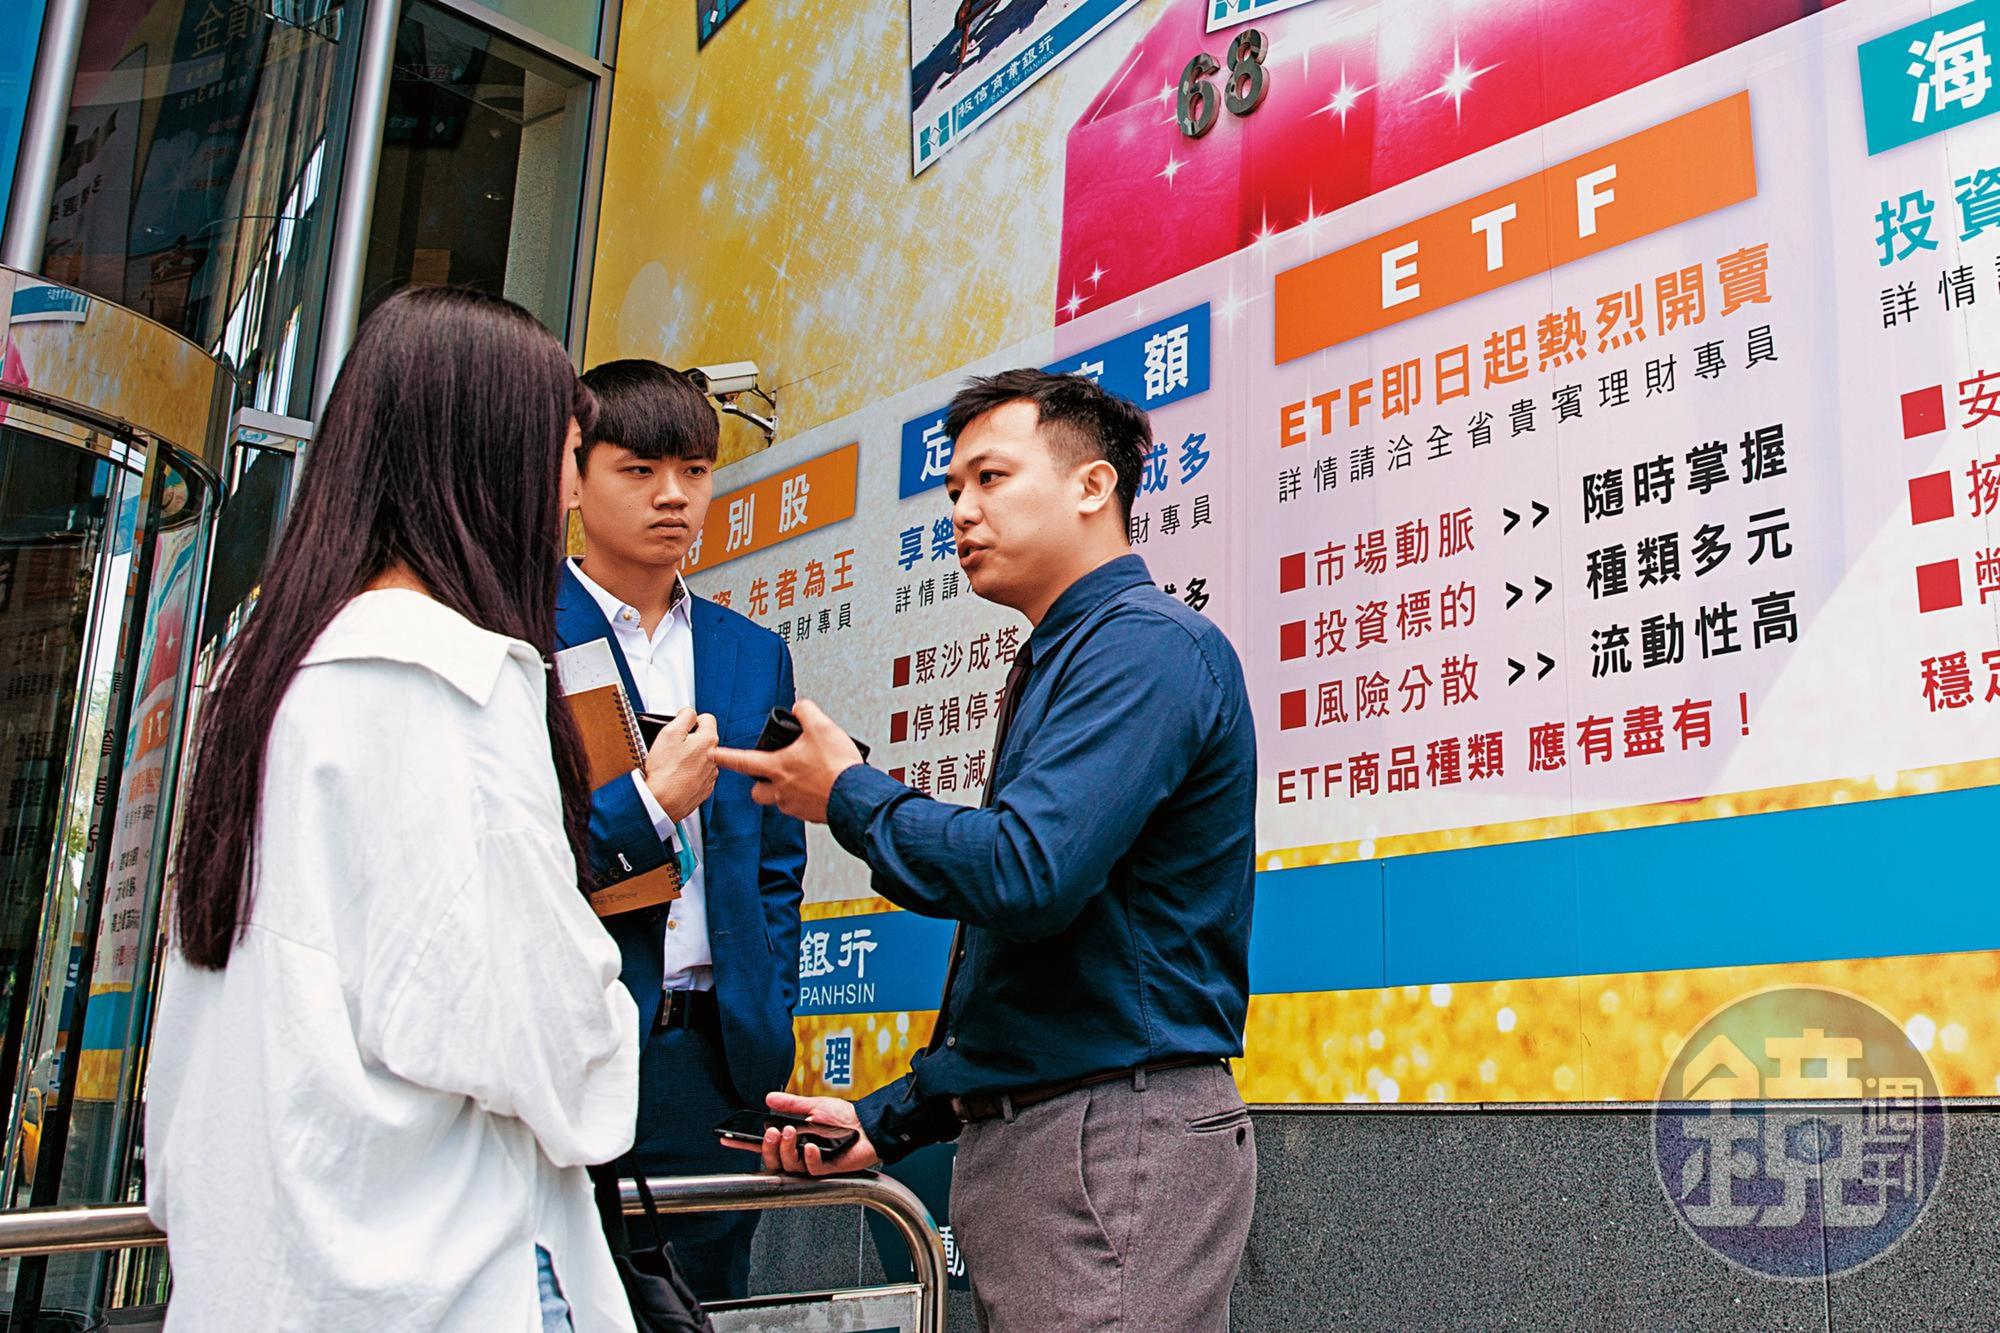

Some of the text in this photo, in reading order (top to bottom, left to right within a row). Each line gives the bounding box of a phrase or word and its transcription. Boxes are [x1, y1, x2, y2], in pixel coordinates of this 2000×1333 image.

[957, 35, 1054, 118] 板信商業銀行
[1177, 29, 1270, 139] 68
[1906, 20, 1992, 123] 海
[1381, 164, 1617, 310] ETF
[1874, 166, 2000, 267] 投資
[1879, 255, 2000, 329] 詳情
[1280, 242, 1773, 449] ETF即日起熱烈開賣
[1278, 324, 1778, 504] 詳情請洽全省貴賓理財專員
[1314, 423, 1788, 588] 市場動脈 隨時掌握
[763, 602, 852, 646] 理財專員
[894, 570, 976, 615] 詳情請
[1314, 507, 1793, 659] 投資標的 種類多元
[915, 625, 1020, 685] 聚沙成塔
[1314, 590, 1799, 729] 風險分散 流動性高
[1278, 732, 1504, 804] ETF商品種類
[799, 929, 878, 979] 銀行
[800, 982, 875, 1007] PANHSIN
[824, 1036, 851, 1085] 理
